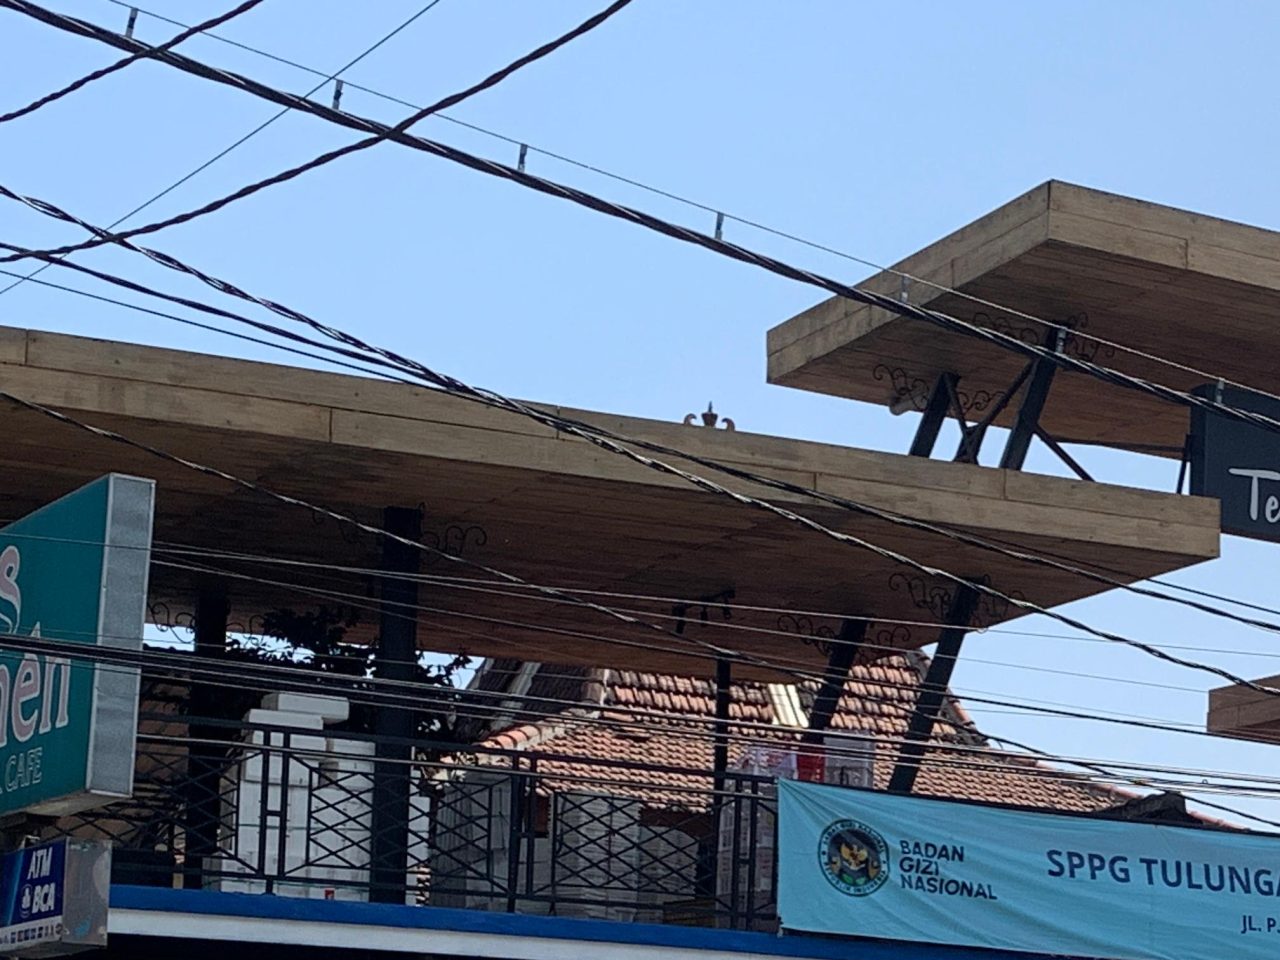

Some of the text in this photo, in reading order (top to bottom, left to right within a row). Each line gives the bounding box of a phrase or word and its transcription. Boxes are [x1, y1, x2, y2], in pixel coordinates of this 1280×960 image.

[27, 847, 53, 880] ATM
[900, 840, 964, 862] BADAN
[899, 857, 939, 876] GIZI
[1047, 850, 1131, 884] SPPG
[32, 882, 56, 914] BCA
[901, 875, 997, 900] NASIONAL
[1241, 915, 1262, 934] JL.
[1267, 918, 1280, 933] P.
